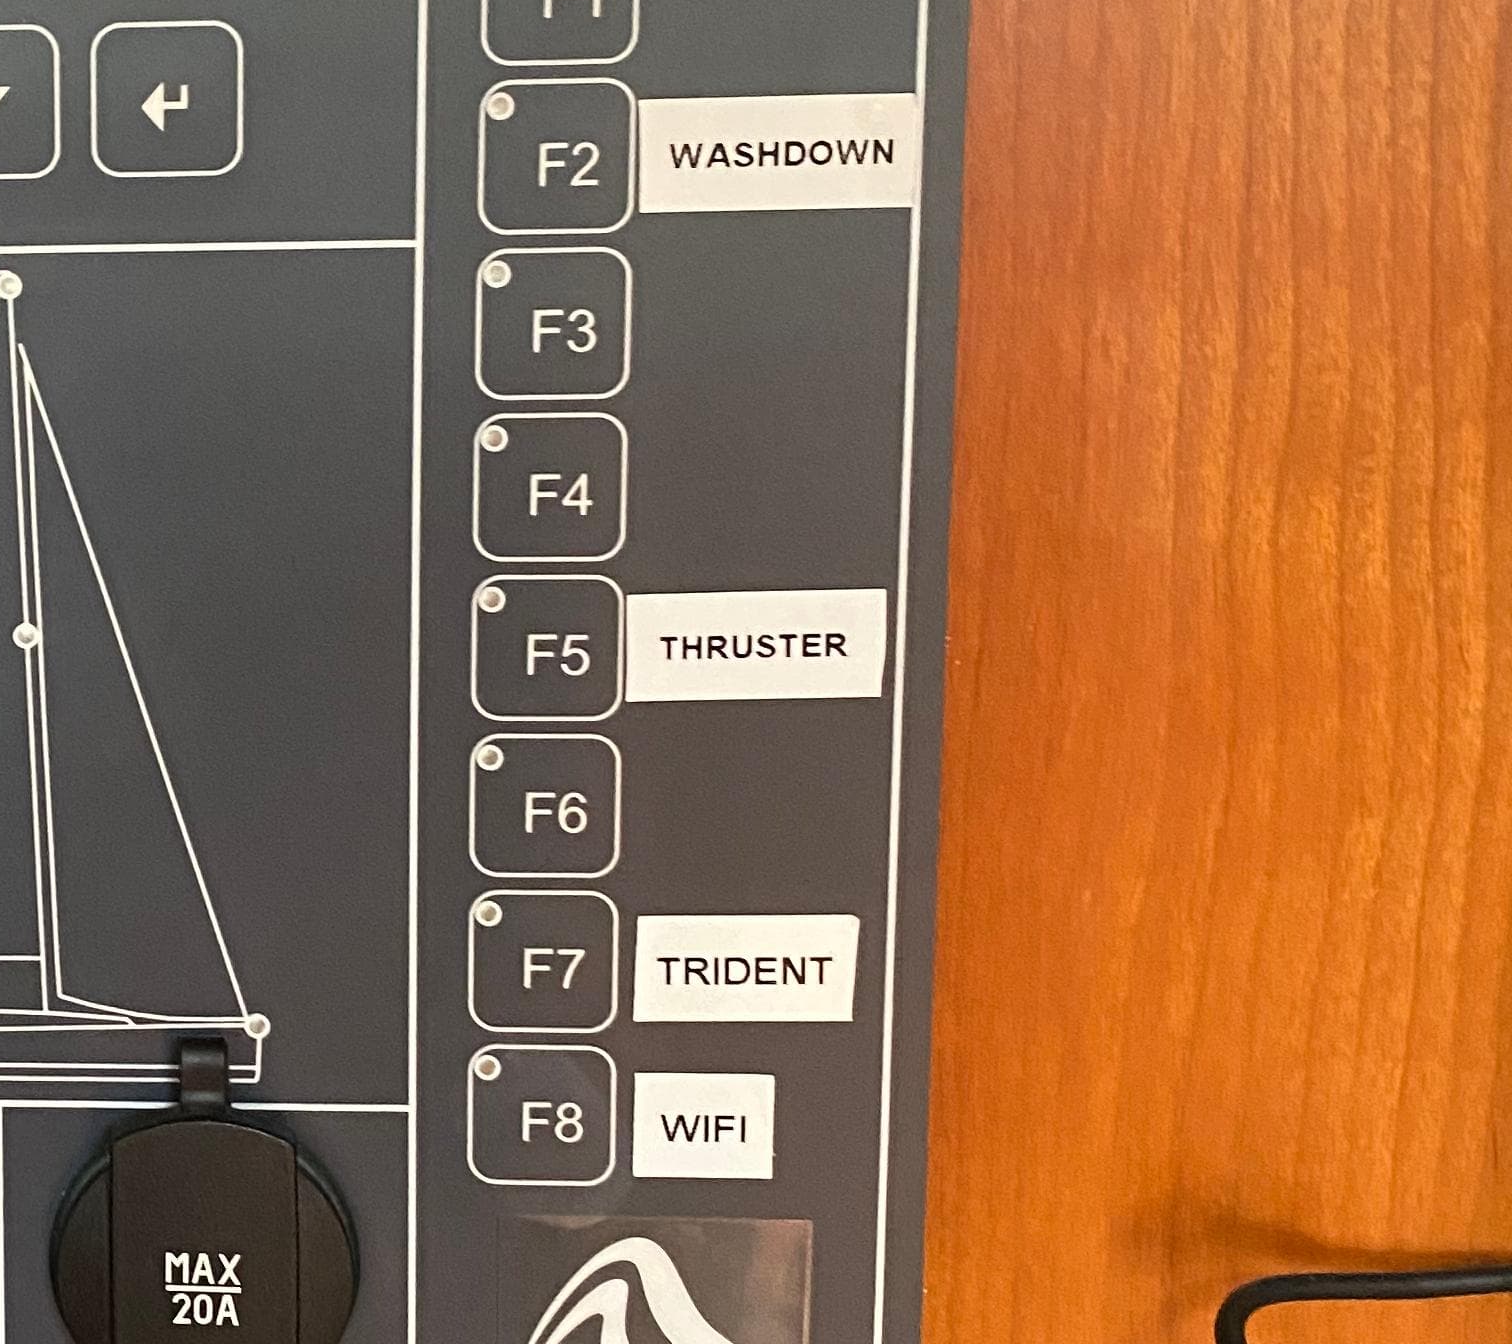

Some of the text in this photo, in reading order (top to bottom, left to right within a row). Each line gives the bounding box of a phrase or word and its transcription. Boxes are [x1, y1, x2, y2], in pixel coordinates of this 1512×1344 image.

[538, 141, 600, 188] F2
[669, 138, 894, 169] WASHDOWN
[532, 308, 597, 353] F3
[529, 473, 593, 517] F4
[526, 633, 591, 676] F5
[659, 632, 848, 660] THRUSTER
[524, 791, 588, 834] F6
[523, 947, 586, 990] F7
[656, 956, 833, 986] TRIDENT
[522, 1101, 584, 1143] F8
[660, 1114, 746, 1144] WIFI
[164, 1252, 242, 1285] MAX
[171, 1294, 240, 1327] 20A
